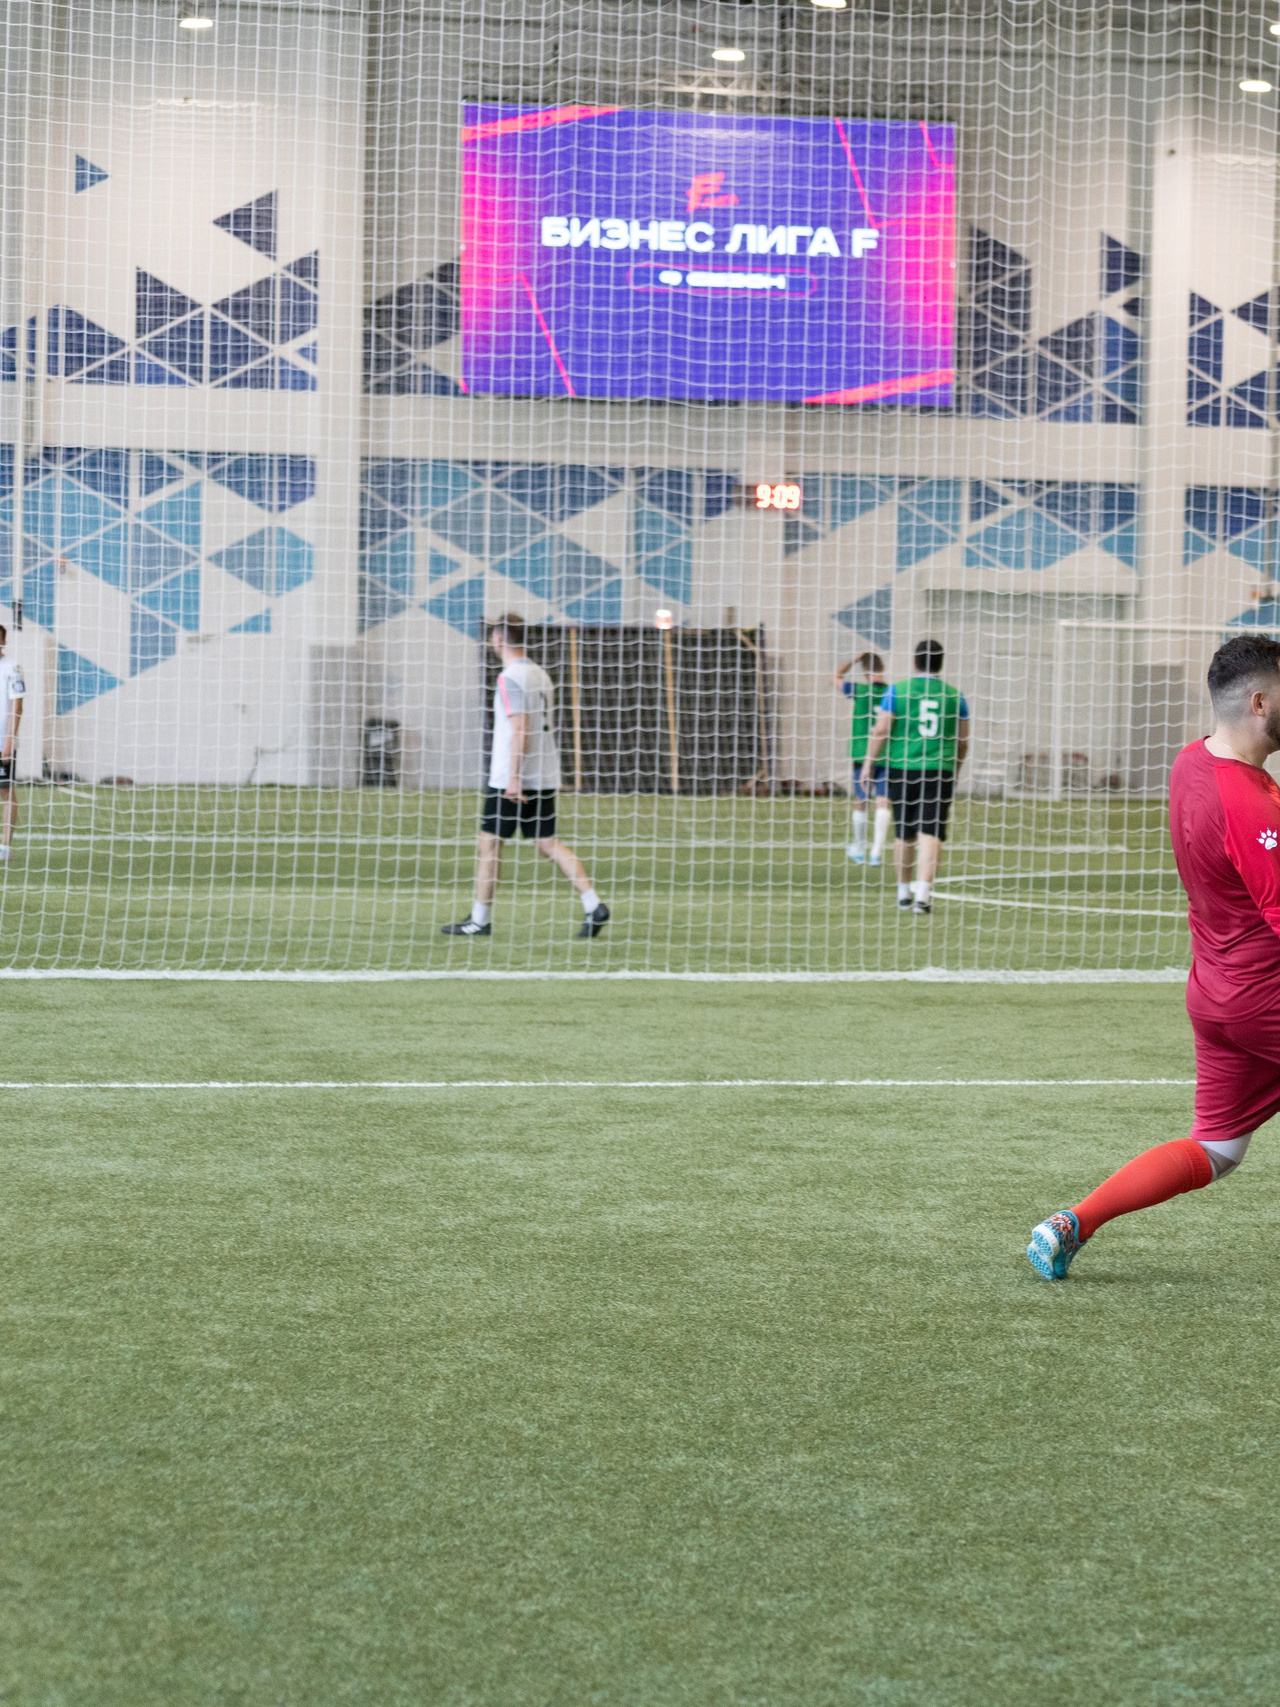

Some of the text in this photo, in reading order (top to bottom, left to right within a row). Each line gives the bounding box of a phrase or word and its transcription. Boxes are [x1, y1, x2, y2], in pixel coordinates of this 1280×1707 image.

[542, 216, 879, 258] БИЗНЕС ЛИГА F
[918, 700, 939, 737] 5
